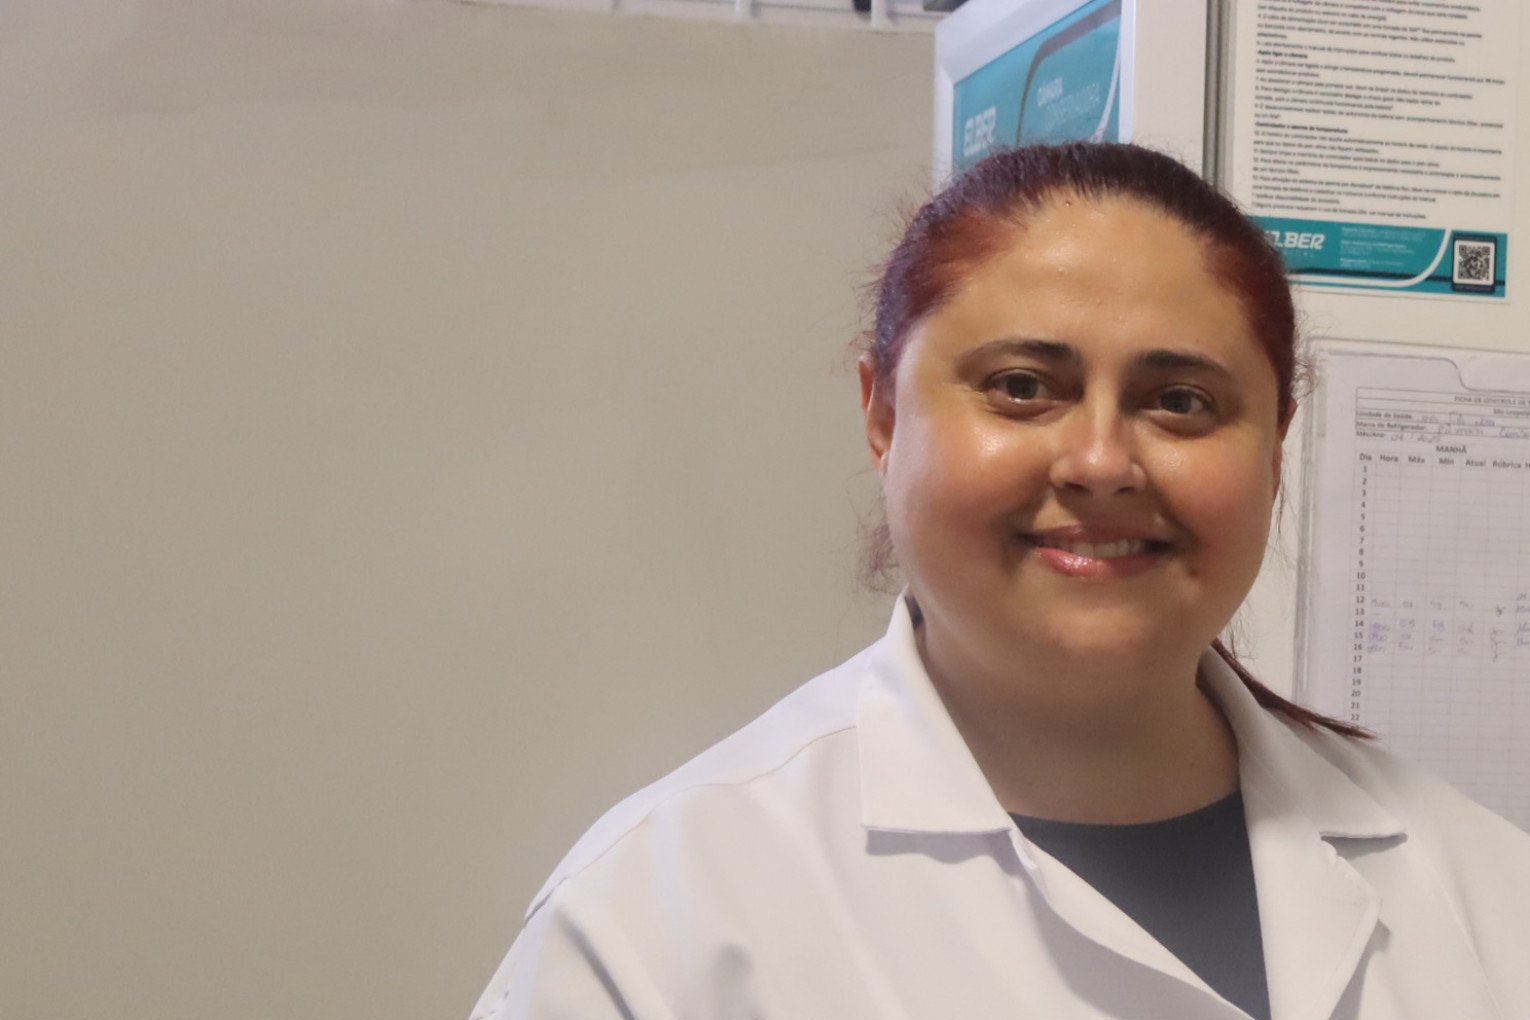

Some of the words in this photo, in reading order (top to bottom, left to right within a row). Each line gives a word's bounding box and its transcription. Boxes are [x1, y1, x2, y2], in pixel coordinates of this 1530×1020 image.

[1436, 445, 1467, 454] MANHÃ
[1360, 453, 1372, 461] Dia
[1380, 454, 1399, 463] Hora
